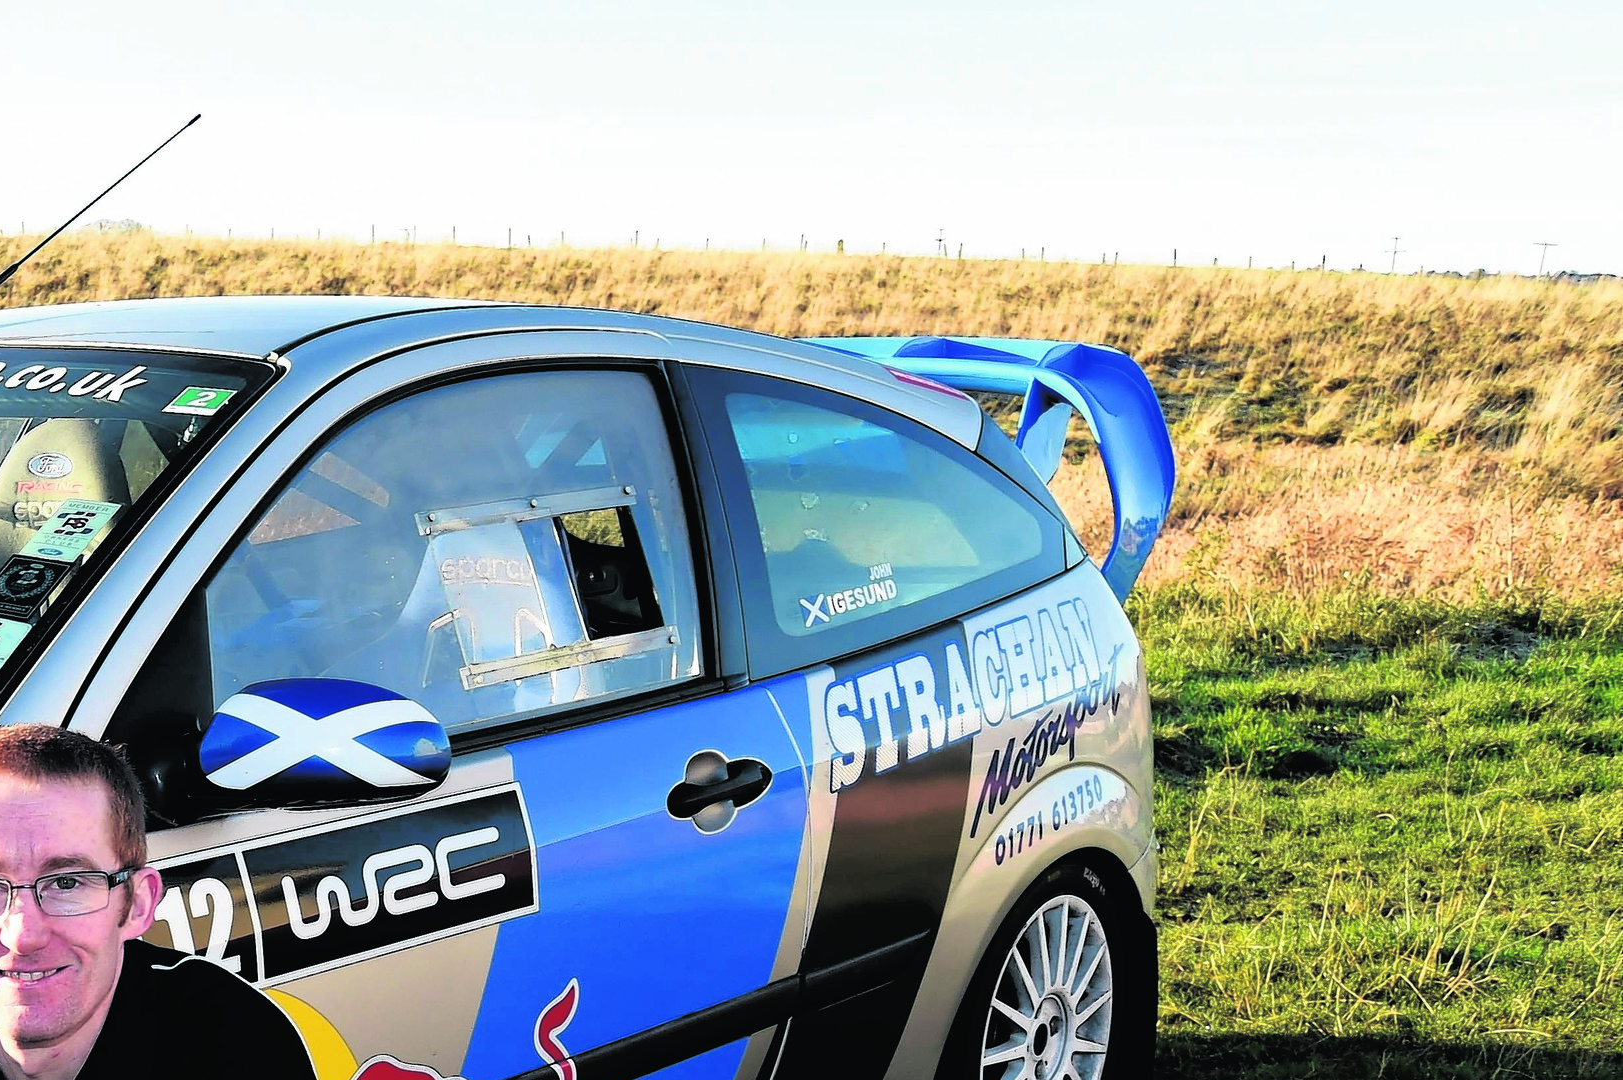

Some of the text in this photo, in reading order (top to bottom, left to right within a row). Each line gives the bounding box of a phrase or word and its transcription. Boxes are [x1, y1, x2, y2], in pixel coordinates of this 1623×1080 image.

[186, 390, 217, 407] 2
[16, 480, 83, 494] RACING
[826, 578, 898, 616] IGESUND
[869, 562, 893, 581] JOHN
[824, 597, 1102, 794] STRACHAN
[970, 643, 1124, 838] Motorsport
[994, 774, 1103, 866] 01771 613750
[154, 826, 506, 972] 12 WRC
